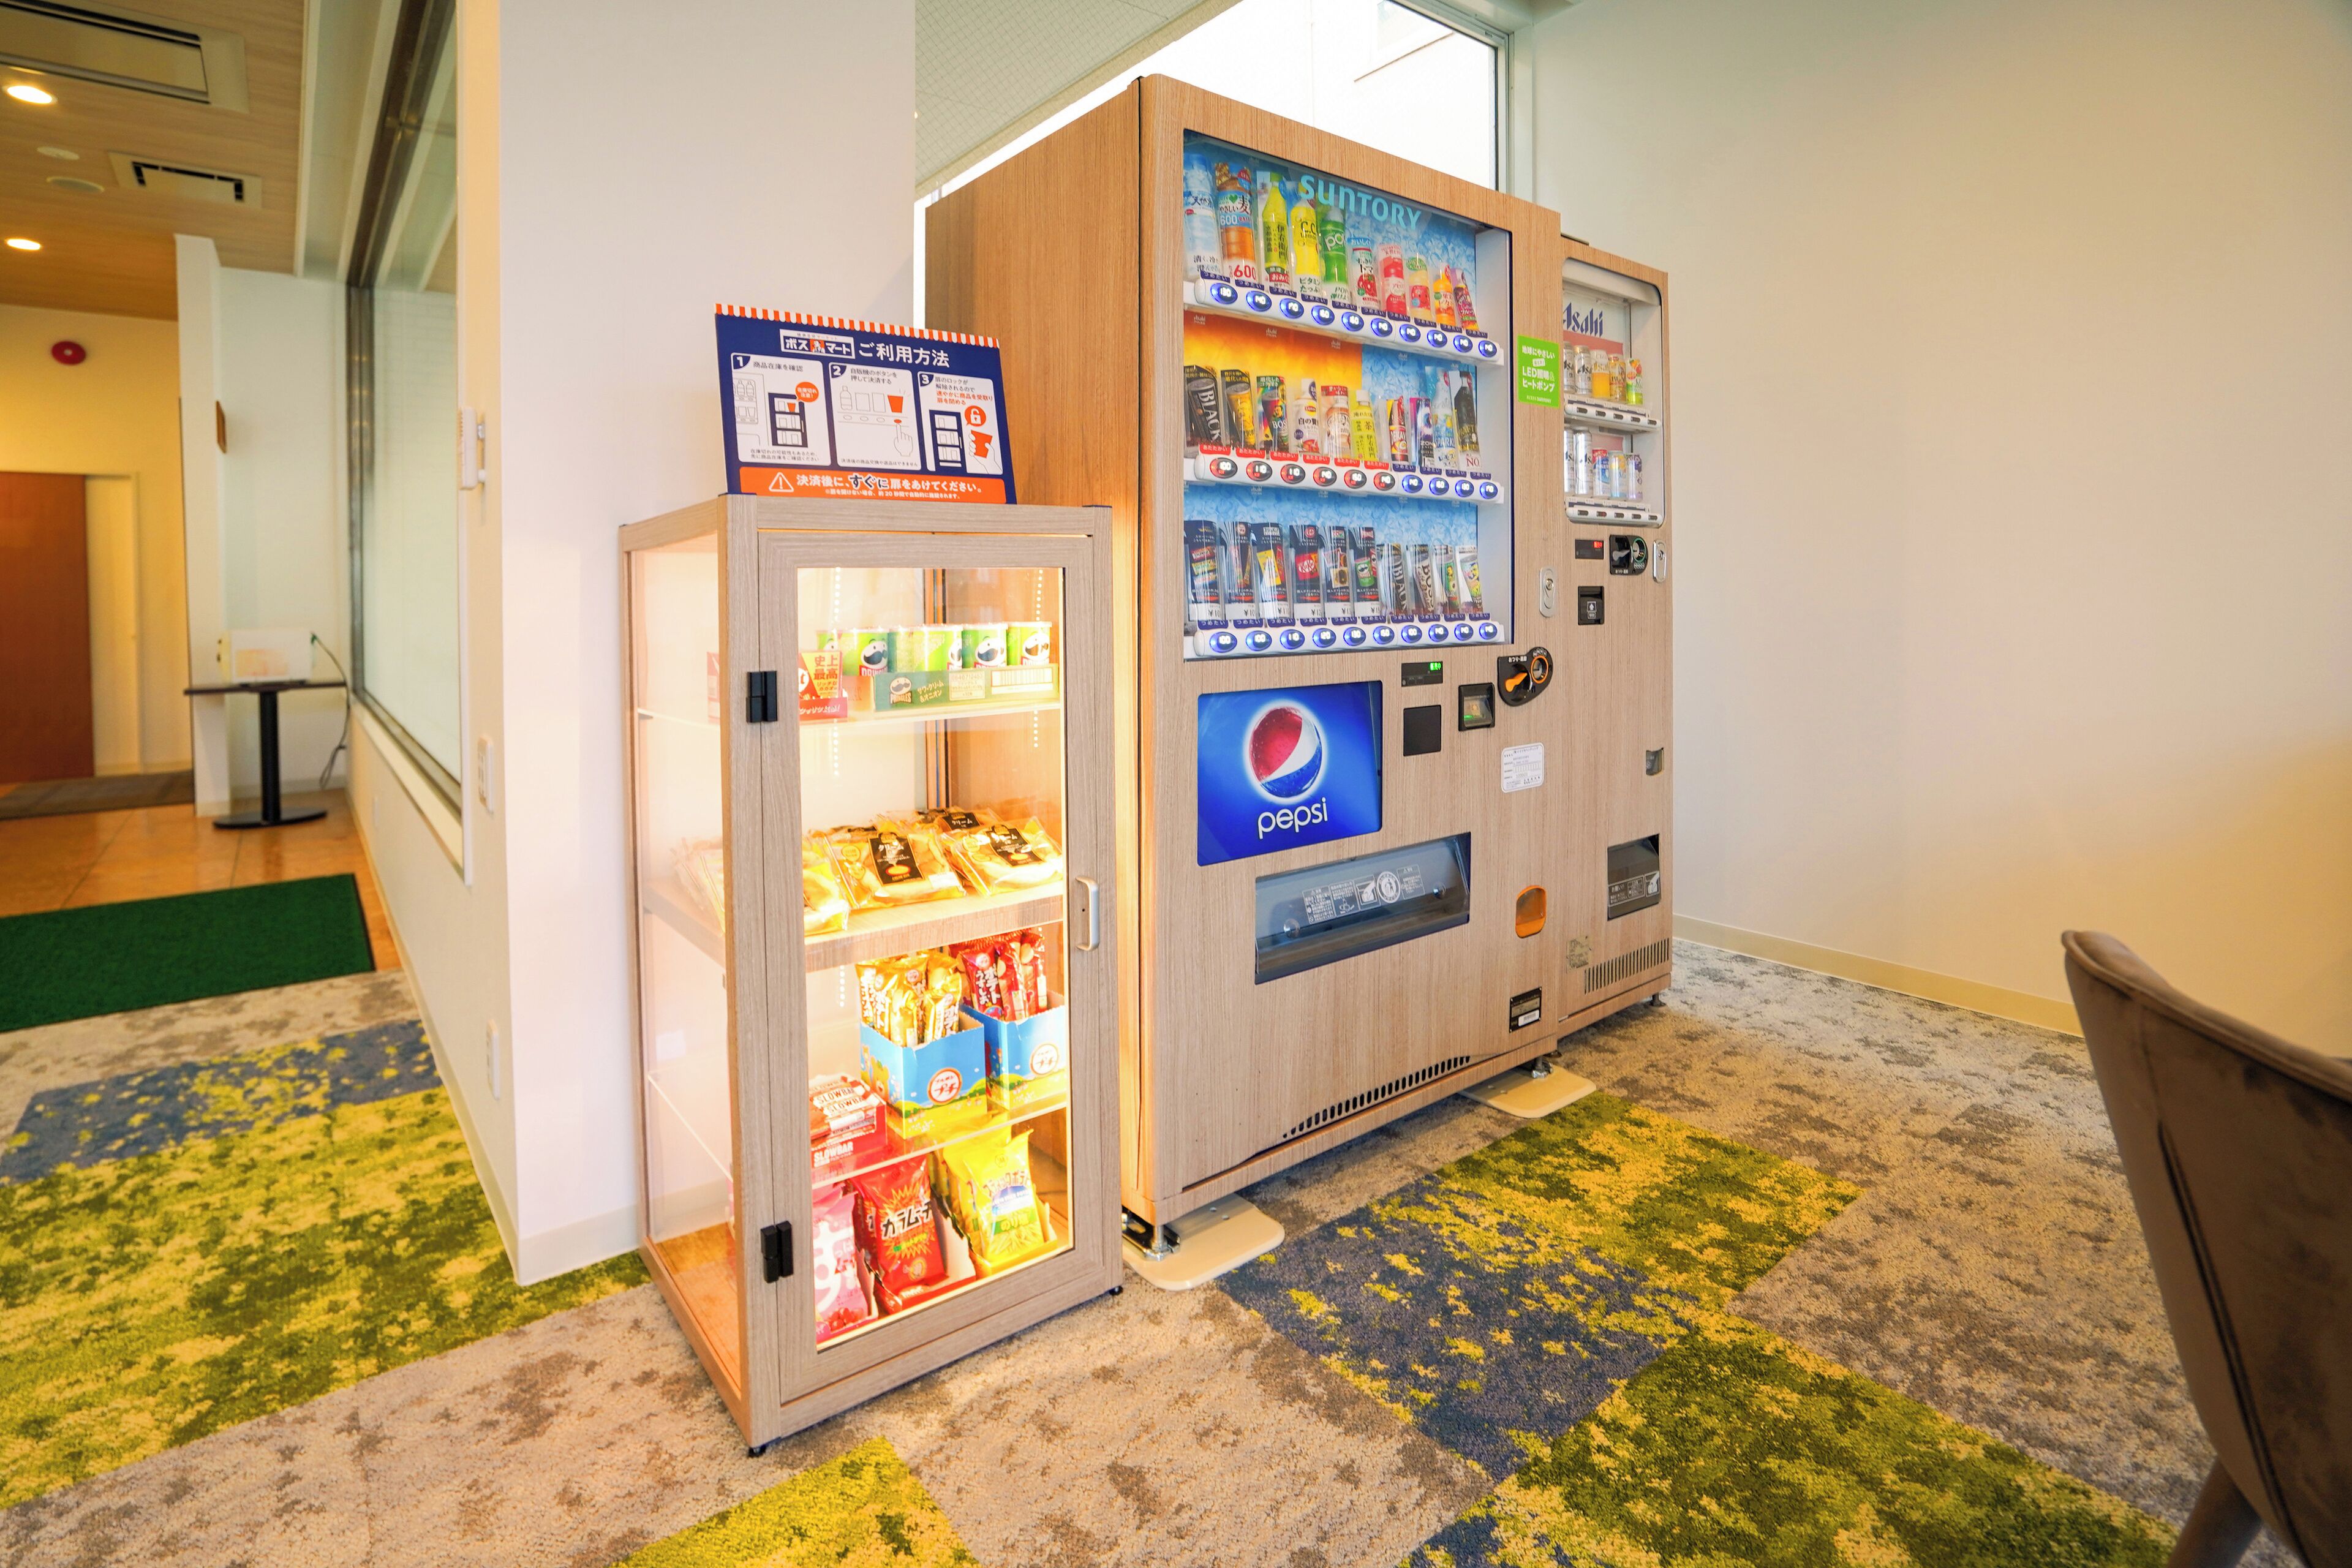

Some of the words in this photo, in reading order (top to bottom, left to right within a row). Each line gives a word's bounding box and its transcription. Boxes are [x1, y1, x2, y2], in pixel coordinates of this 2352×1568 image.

[1300, 175, 1422, 230] SUNTORY
[1220, 215, 1238, 225] 600
[785, 337, 809, 351] ボス
[825, 342, 851, 355] マート
[1522, 345, 1555, 359] 地球にやさしい
[736, 356, 744, 367] 1
[859, 342, 950, 368] ご利用方法
[753, 361, 803, 372] 商品在庫を確認
[832, 366, 842, 376] 2
[851, 368, 897, 378] 自販機のボタンを
[851, 376, 892, 385] 押して決済する
[921, 375, 930, 384] 3
[935, 376, 968, 385] 扉のロックが
[1523, 378, 1555, 392] ヒートポンプ
[935, 383, 976, 393] 解除されるので
[937, 390, 993, 401] 速やかに商品を受取り
[1197, 390, 1222, 442] BLACK
[796, 473, 982, 493] 決済後に、すぐに扉をあけてください。
[814, 655, 838, 667] 史上
[813, 668, 838, 680] 最高
[890, 692, 912, 704] PRINGLES
[920, 689, 942, 703] &オニオン
[1257, 796, 1329, 840] pepsi
[975, 970, 989, 1005] うすしお
[984, 962, 1001, 1005] ポテト
[934, 1082, 958, 1098] プチ
[814, 1141, 854, 1162] SLOWBAR
[881, 1200, 933, 1240] カラムーチ
